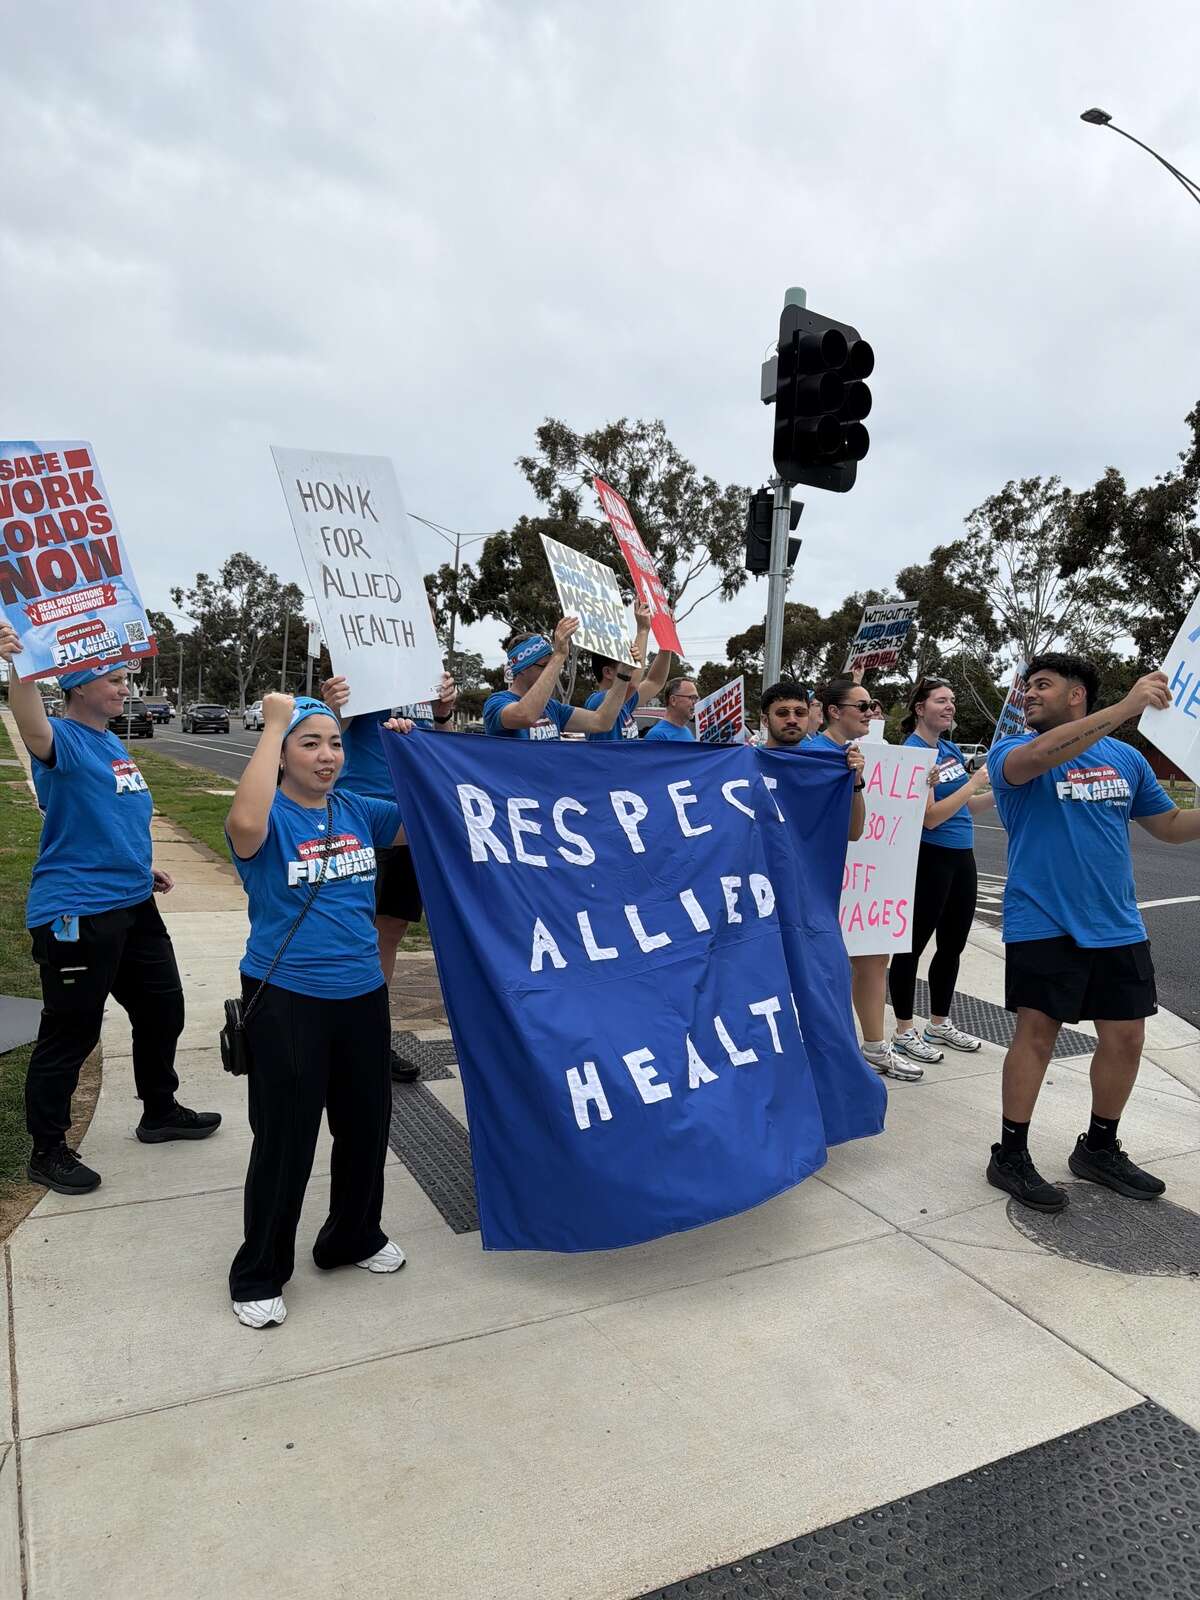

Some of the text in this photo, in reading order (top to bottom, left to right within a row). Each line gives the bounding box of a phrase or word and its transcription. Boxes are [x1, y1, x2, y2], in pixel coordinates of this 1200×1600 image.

[296, 479, 379, 522] HONK
[321, 526, 371, 559] FOR
[0, 535, 122, 605] NOW
[321, 564, 401, 603] ALLIED
[38, 587, 104, 613] REAL PROTECTIONS
[41, 596, 106, 622] AGAINST BURNOUT
[560, 584, 628, 629] MASSIVE
[865, 608, 902, 622] WITHOUT
[53, 631, 115, 665] FIX ALLIED
[87, 639, 118, 654] HEALTH
[340, 614, 415, 650] HEALTH
[852, 643, 867, 655] THE
[698, 682, 741, 720] WE WON'T
[699, 693, 741, 733] SETTLE
[700, 725, 716, 741] FOR
[867, 762, 925, 799] ALE
[1093, 778, 1129, 792] ALLIED
[1093, 787, 1131, 801] HEALTH
[310, 844, 326, 853] MOR
[330, 840, 345, 849] AND
[288, 847, 375, 886] FIX ALLIED
[337, 858, 376, 877] HEALTH
[530, 873, 777, 972] ALLIED
[566, 992, 804, 1130] HEALT
